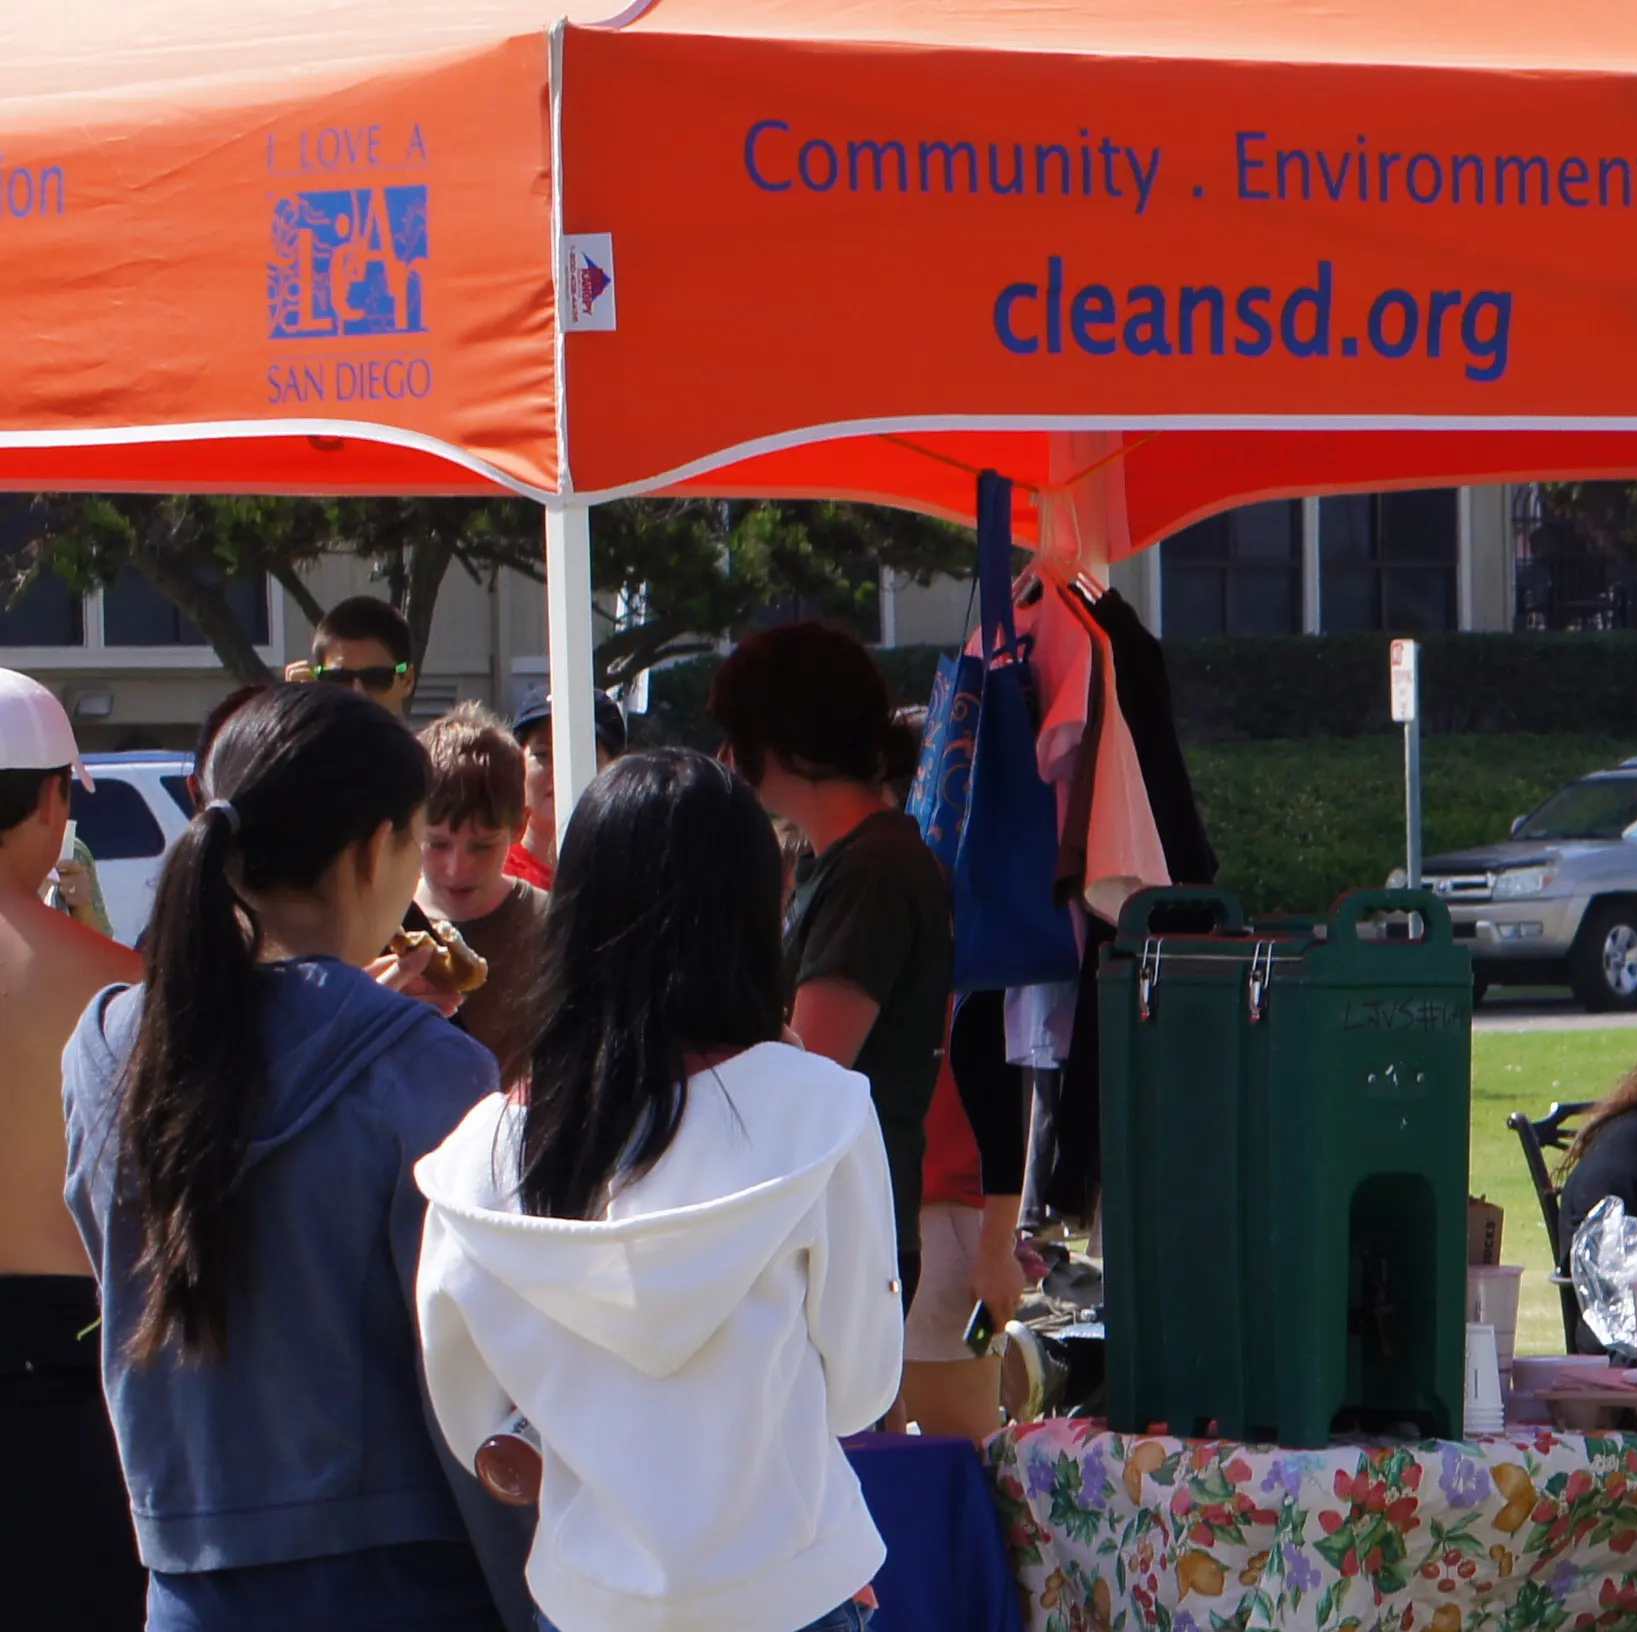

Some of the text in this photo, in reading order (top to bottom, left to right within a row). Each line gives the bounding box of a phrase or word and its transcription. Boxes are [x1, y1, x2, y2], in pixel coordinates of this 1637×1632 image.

[267, 122, 428, 170] I LOVE A
[743, 119, 1162, 215] Community
[993, 255, 1514, 382] cleansd.org
[267, 358, 432, 404] SAN DIEGO
[1482, 1219, 1496, 1265] UCKS
